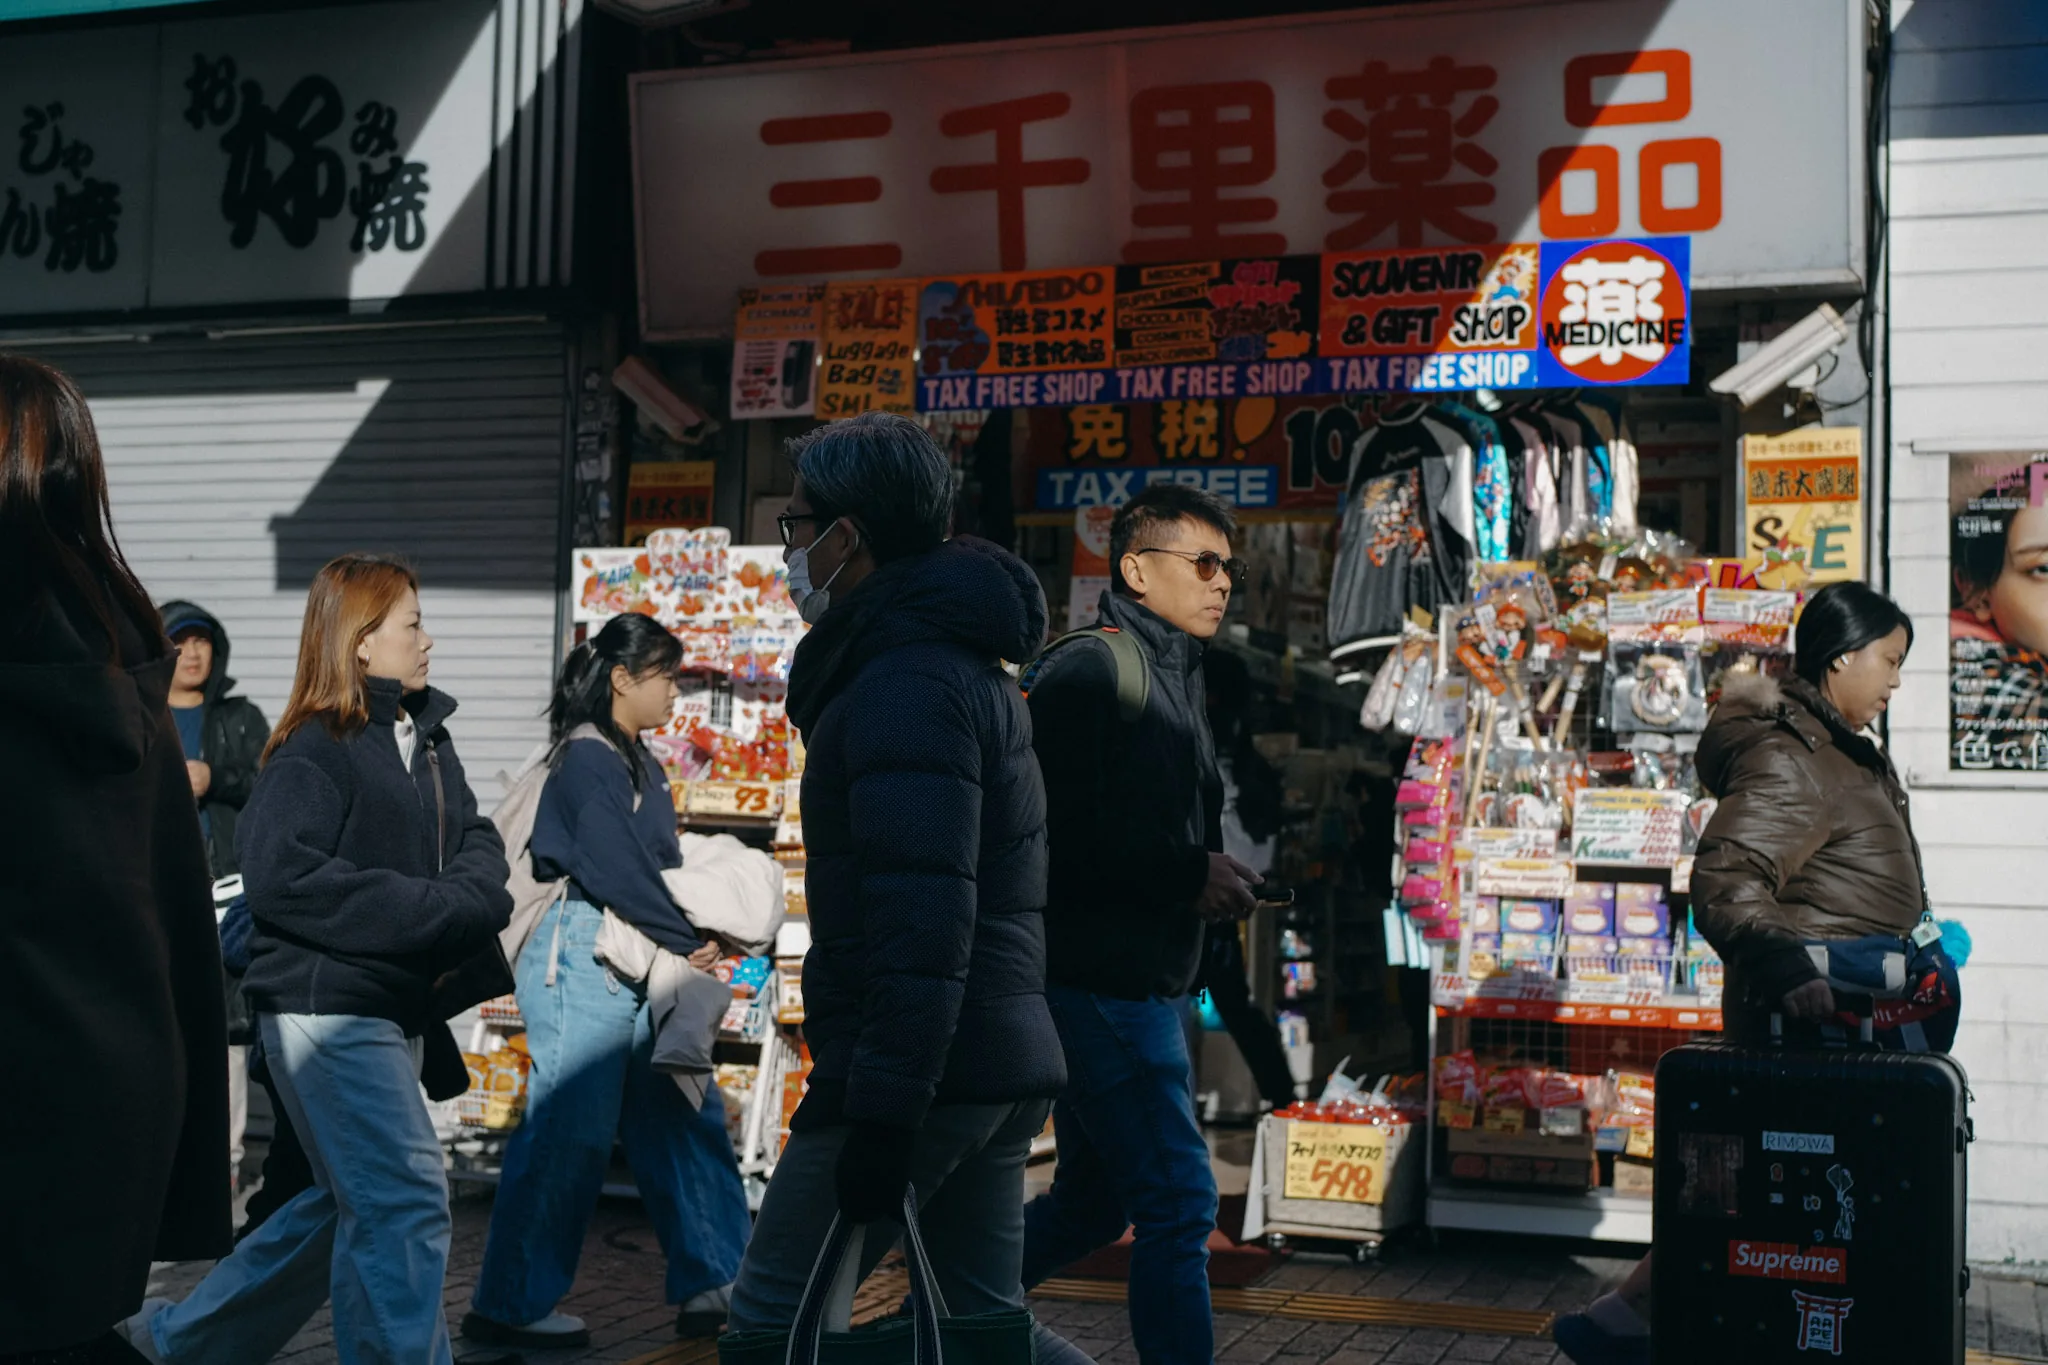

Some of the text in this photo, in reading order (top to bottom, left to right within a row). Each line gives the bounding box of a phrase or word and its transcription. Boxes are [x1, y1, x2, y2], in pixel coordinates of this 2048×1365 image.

[753, 48, 1723, 276] 三千里薬品
[942, 271, 1104, 313] SHISEIDO
[1332, 251, 1483, 298] SOUVENIR
[1372, 307, 1440, 346] GIFT
[1450, 304, 1528, 345] SHOP
[1544, 318, 1685, 348] MEDICINE
[825, 340, 911, 361] Luggage
[827, 363, 877, 385] Bag
[923, 377, 972, 410] TAX
[975, 375, 1039, 408] FREE
[1042, 371, 1106, 404] SHOP
[1116, 361, 1312, 400] TAX FREE SHOP
[1329, 353, 1530, 391] TAX FREE SHOP
[1048, 470, 1135, 505] TAX
[734, 786, 770, 813] 93
[1765, 1134, 1834, 1152] RIMOWA
[1311, 1158, 1373, 1201] 598
[1735, 1243, 1841, 1275] Supreme
